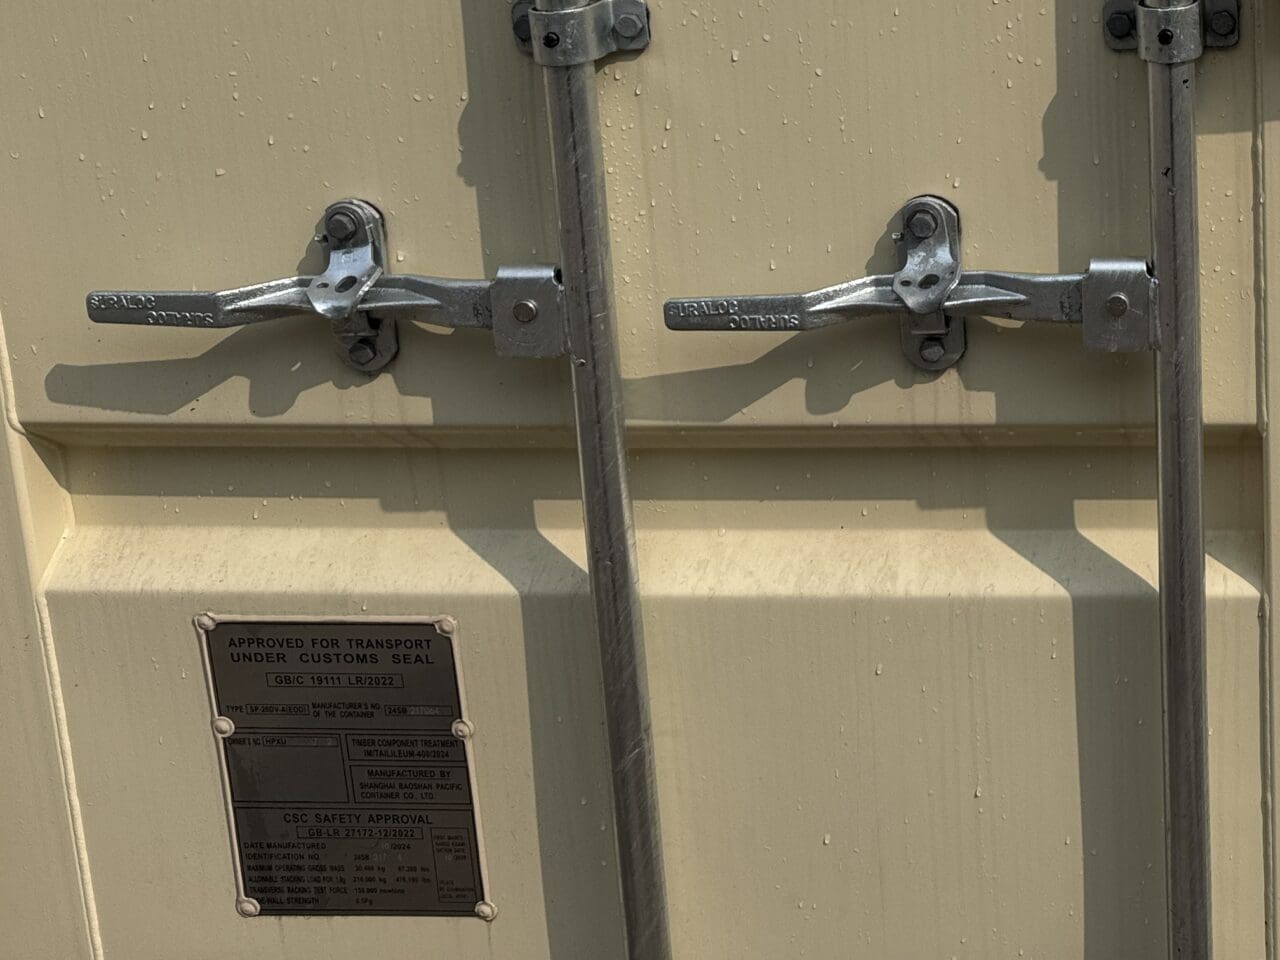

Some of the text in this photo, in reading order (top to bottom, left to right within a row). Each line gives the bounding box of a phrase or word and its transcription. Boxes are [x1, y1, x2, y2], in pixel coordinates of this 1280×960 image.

[228, 637, 432, 649] APPROVED FOR TRANSPORT
[230, 652, 435, 664] UNDER CUSTOMS SEAL
[275, 675, 394, 686] GB/C 19111 LR/2022
[367, 769, 451, 778] MANUFACTURED BY
[360, 782, 395, 790] SHANGHAI
[436, 783, 463, 791] PACIFIC
[360, 791, 400, 800] CONTAINER
[283, 812, 434, 824] CSC SAFETY APPROVAL
[308, 828, 341, 838] GB-LR
[243, 841, 327, 850] DATE MANUFACTURED
[245, 852, 305, 861] IDENTIFICATION
